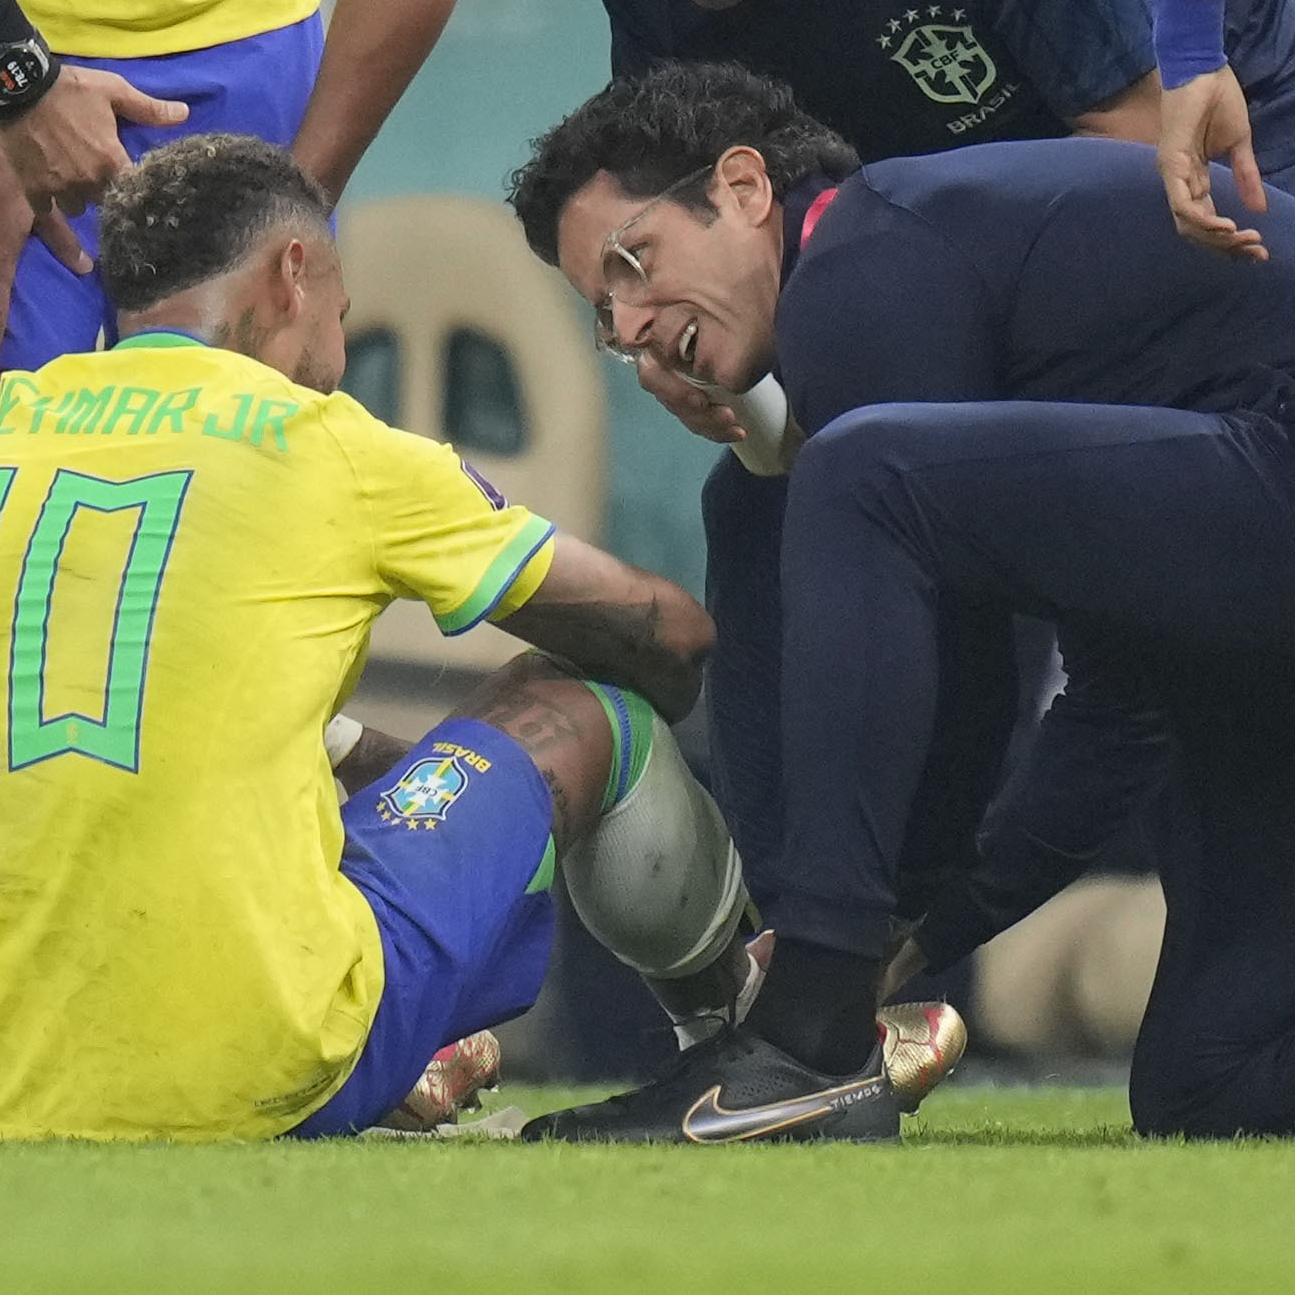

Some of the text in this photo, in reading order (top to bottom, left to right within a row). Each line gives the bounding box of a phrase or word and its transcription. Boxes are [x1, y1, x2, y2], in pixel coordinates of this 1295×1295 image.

[931, 50, 959, 69] CBF
[946, 82, 1020, 134] BRASIL
[202, 393, 300, 453] JR
[432, 742, 492, 773] BRASIL
[415, 784, 438, 797] CBF
